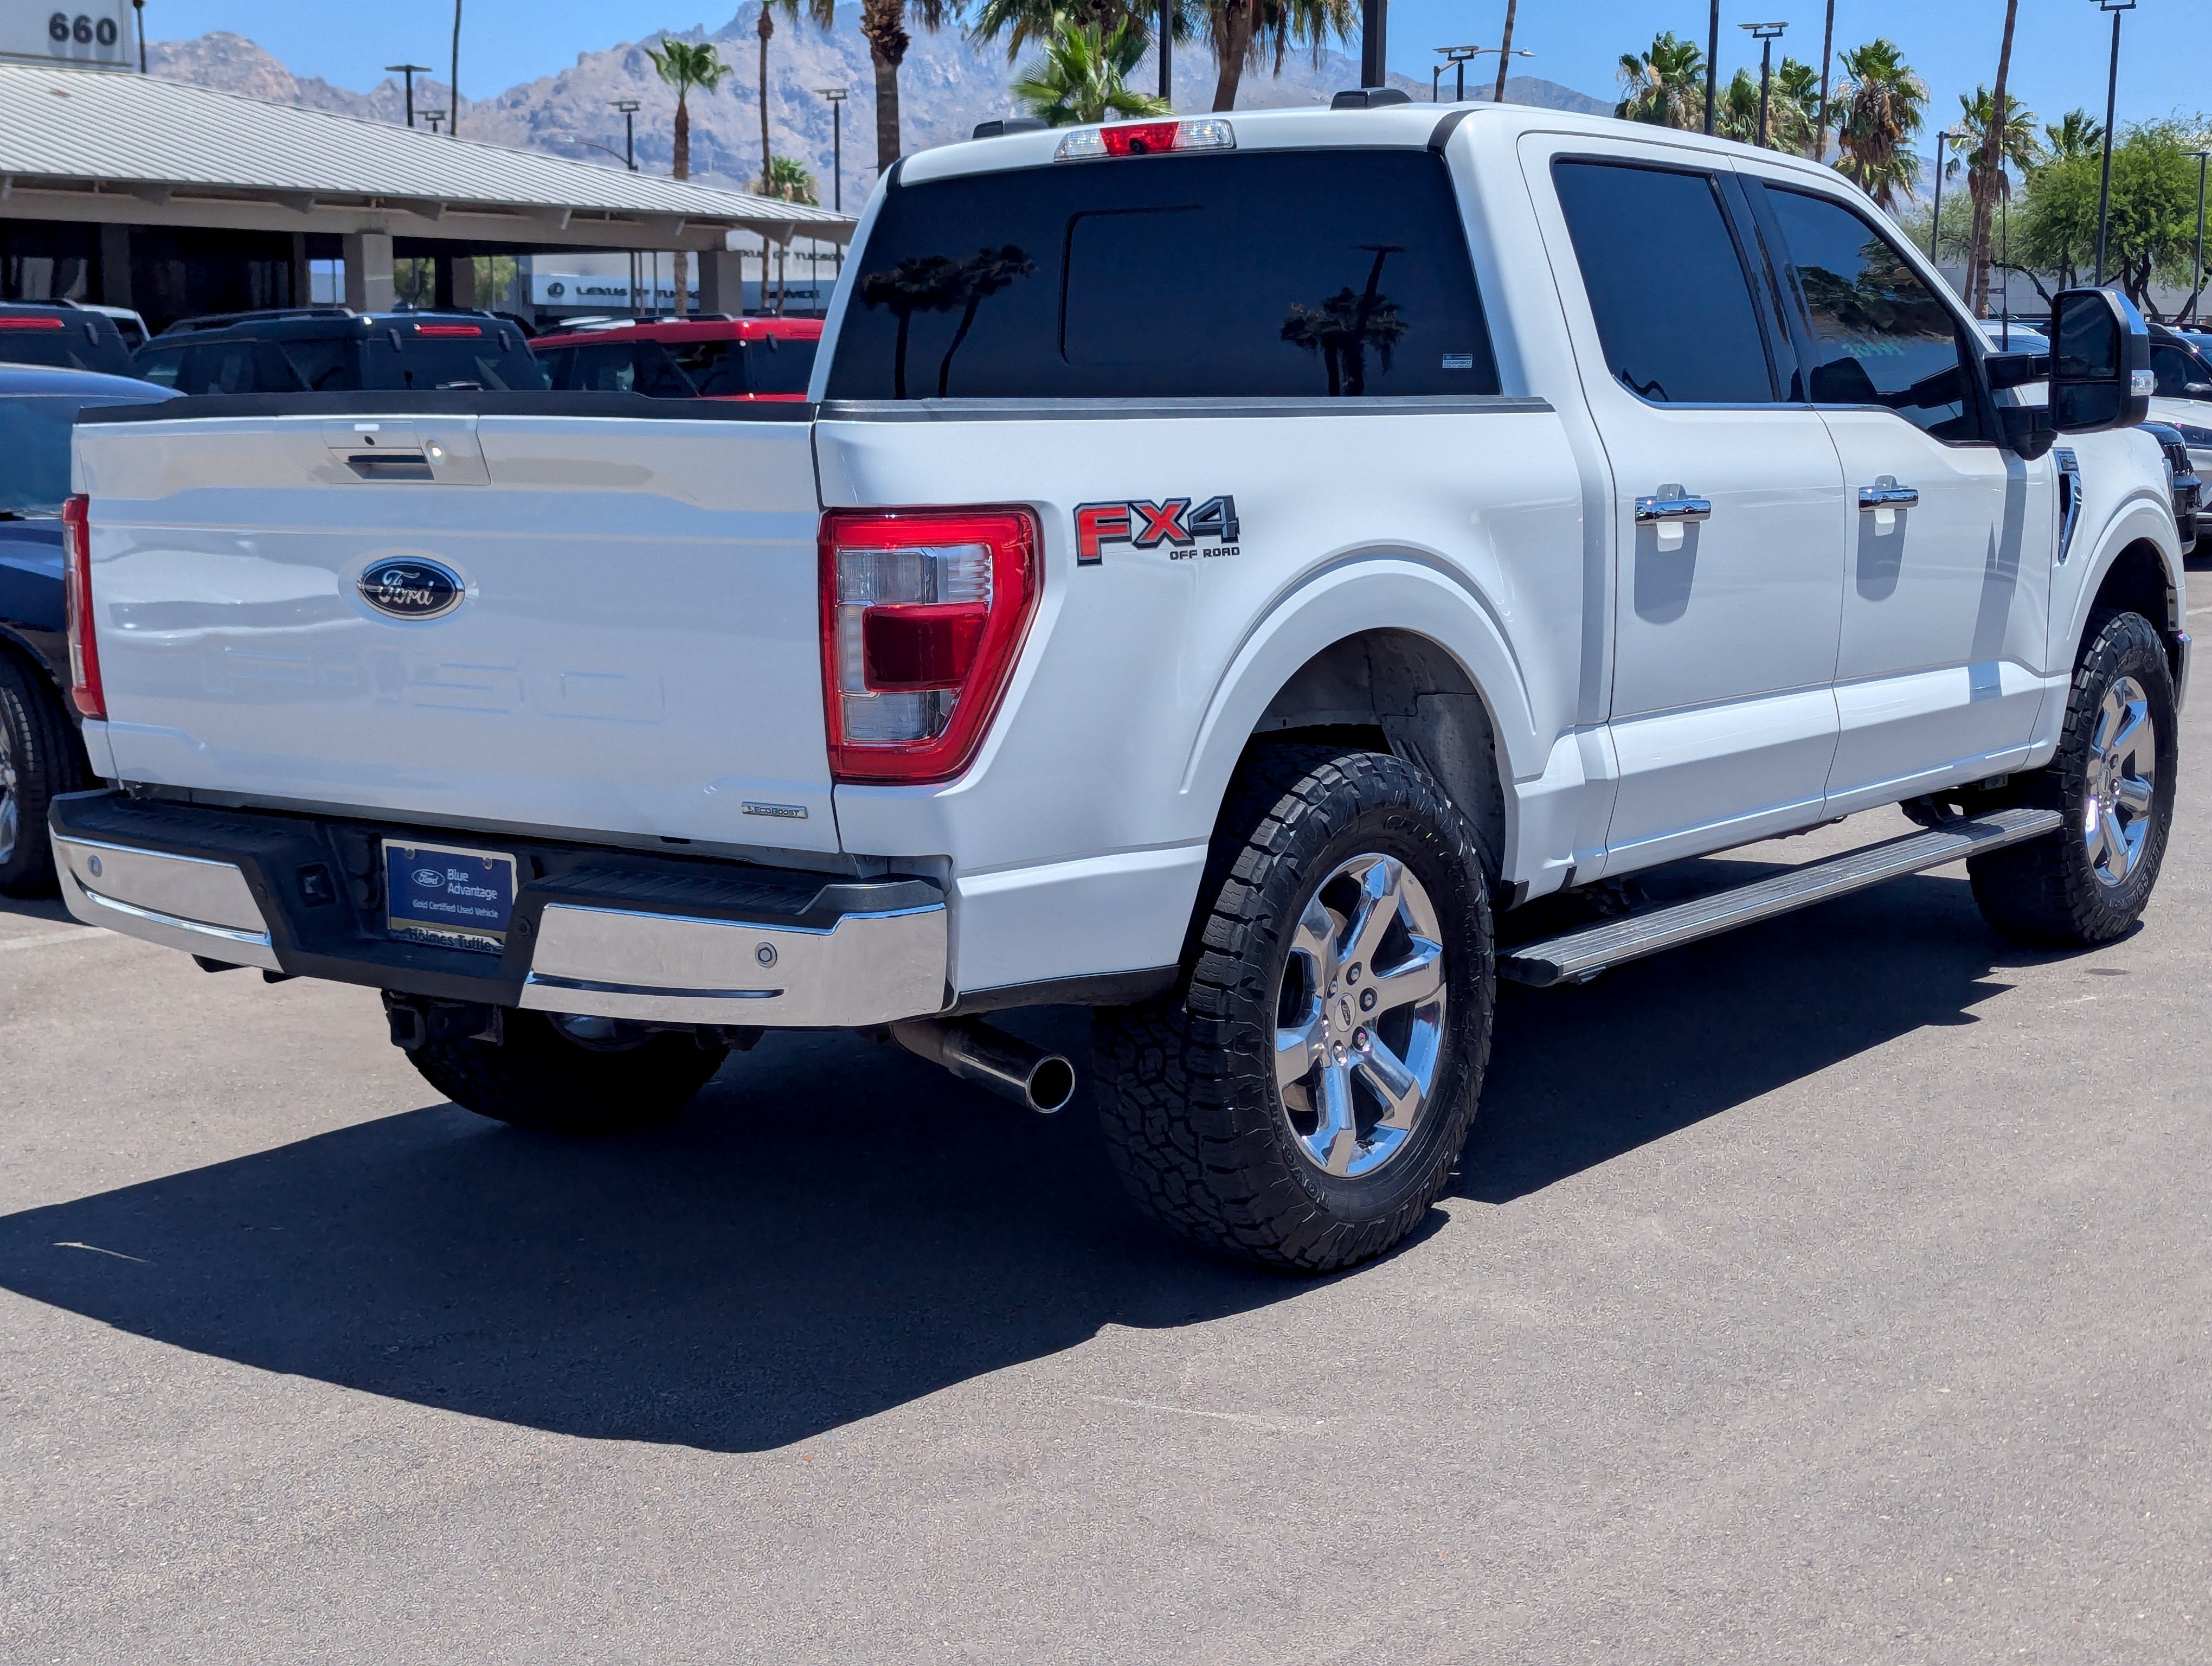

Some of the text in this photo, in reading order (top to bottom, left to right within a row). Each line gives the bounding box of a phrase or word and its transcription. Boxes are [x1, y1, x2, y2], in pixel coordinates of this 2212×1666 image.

[49, 12, 117, 46] 660
[576, 286, 627, 297] LEXUS
[1073, 495, 1240, 567] FX4
[1169, 547, 1240, 560] OFF ROAD
[378, 569, 434, 606] Ford
[418, 870, 439, 885] Ford
[447, 868, 469, 882] Blue
[447, 882, 498, 901] Advantage
[412, 899, 499, 918] Gold Certified Used Vehicle
[411, 927, 493, 952] Holmes Tuttle
